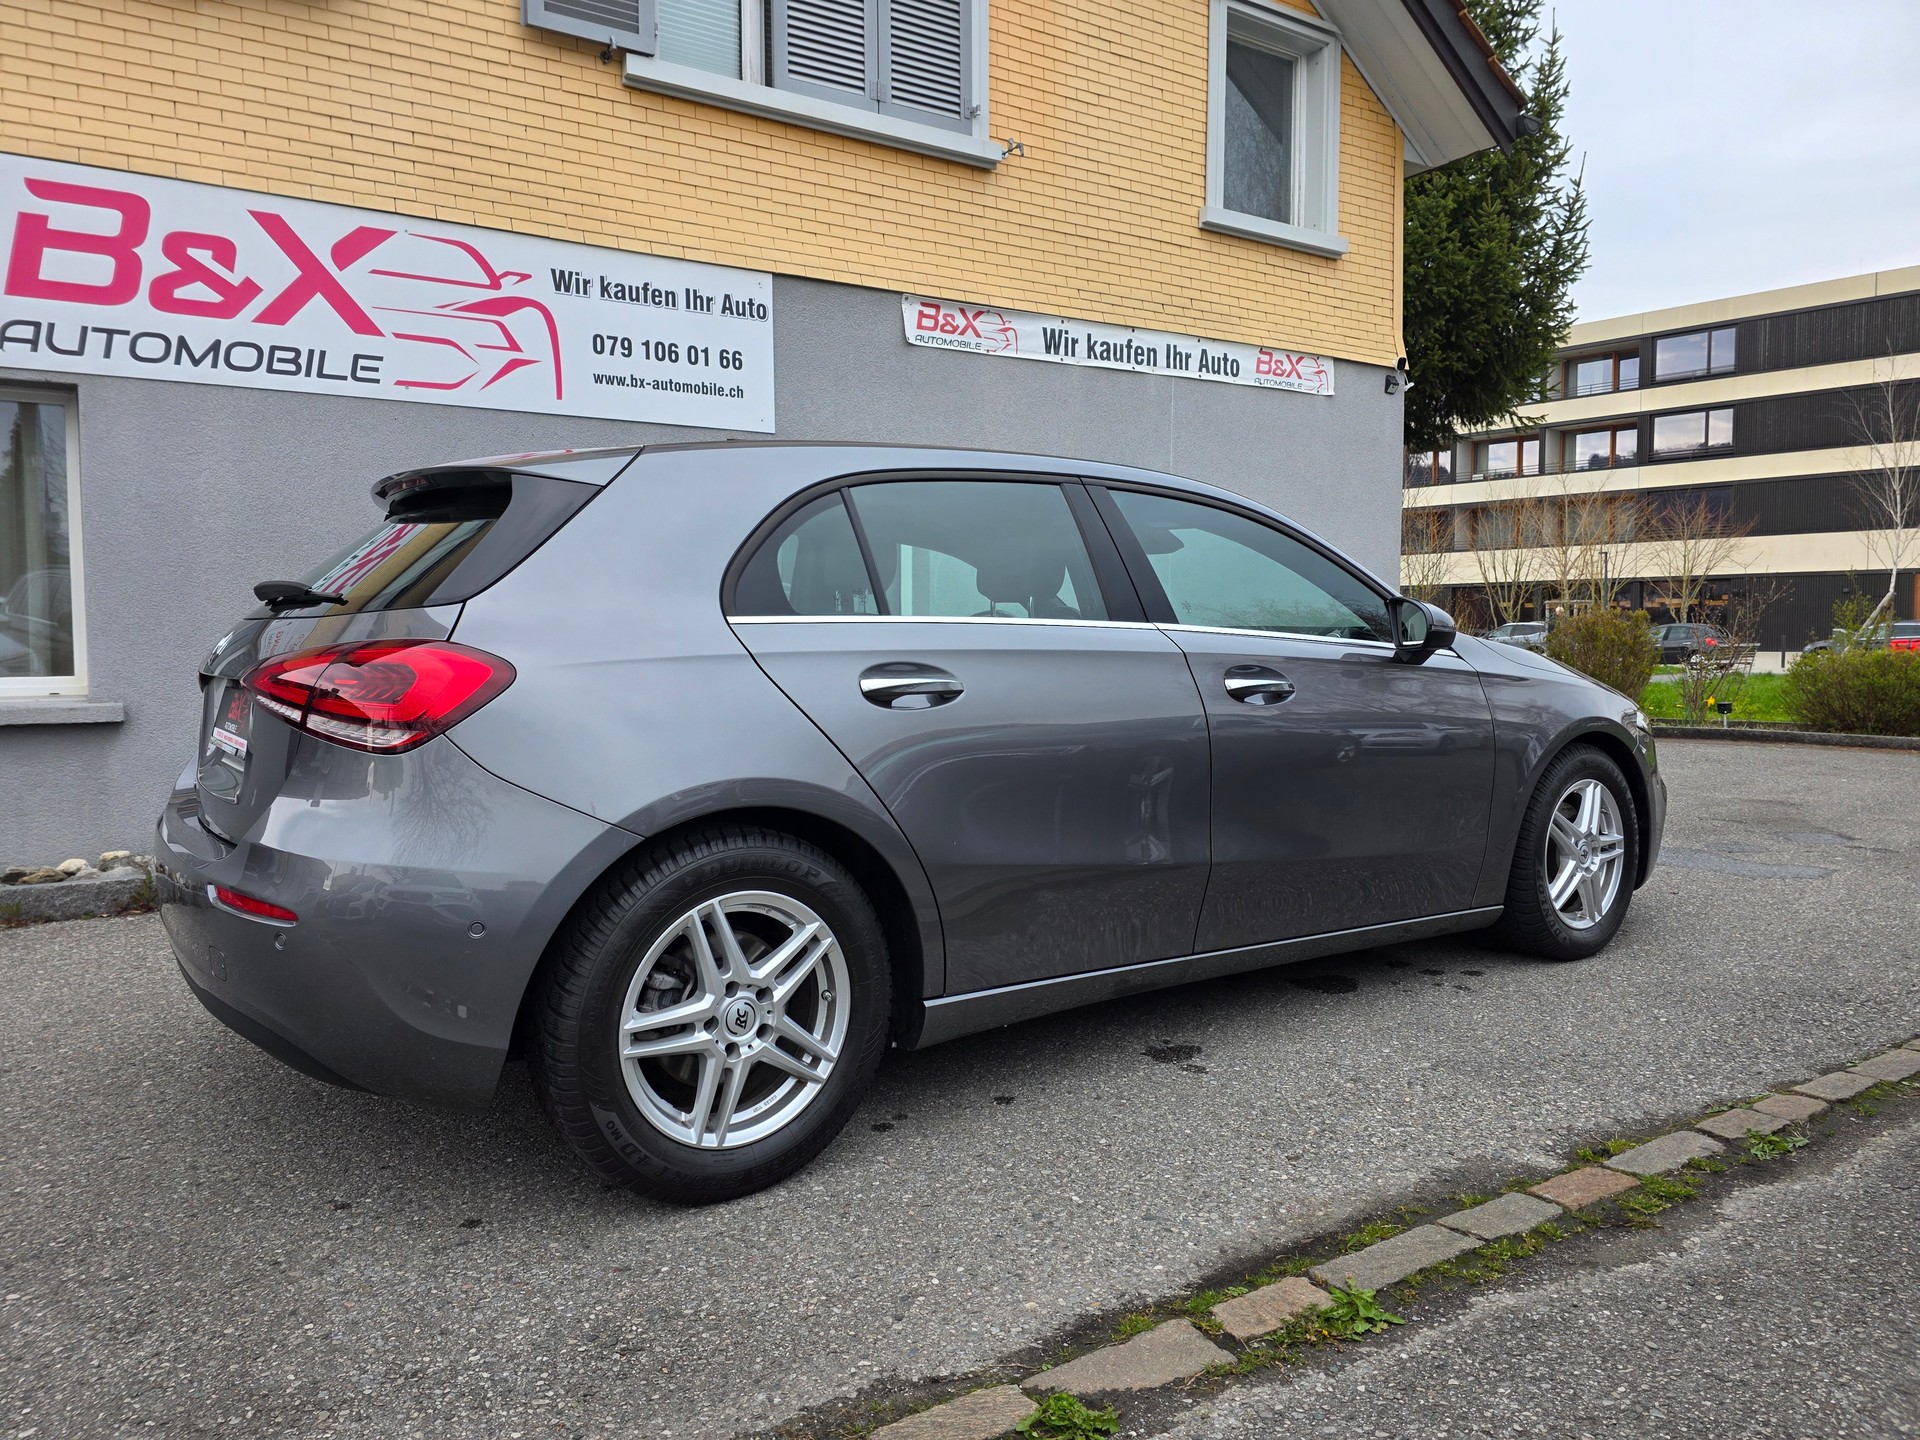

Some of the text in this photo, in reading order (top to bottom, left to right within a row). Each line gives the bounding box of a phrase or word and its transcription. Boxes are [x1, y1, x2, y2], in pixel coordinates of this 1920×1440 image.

[4, 177, 398, 338] B&X
[550, 268, 769, 321] Wir kaufen Ihr Auto
[916, 301, 986, 339] B&X
[0, 320, 384, 384] AUTOMOBILE
[592, 333, 743, 370] 079 106 01 66
[915, 334, 983, 351] AUTOMOBILE
[1042, 327, 1240, 378] Wir kaufen Ihr Auto
[1255, 350, 1306, 380] B&X
[593, 372, 744, 399] www.bx-automobile.ch
[1254, 377, 1303, 390] AUTOMOBILE
[702, 854, 821, 880] DUNLOP
[735, 1008, 749, 1030] RC
